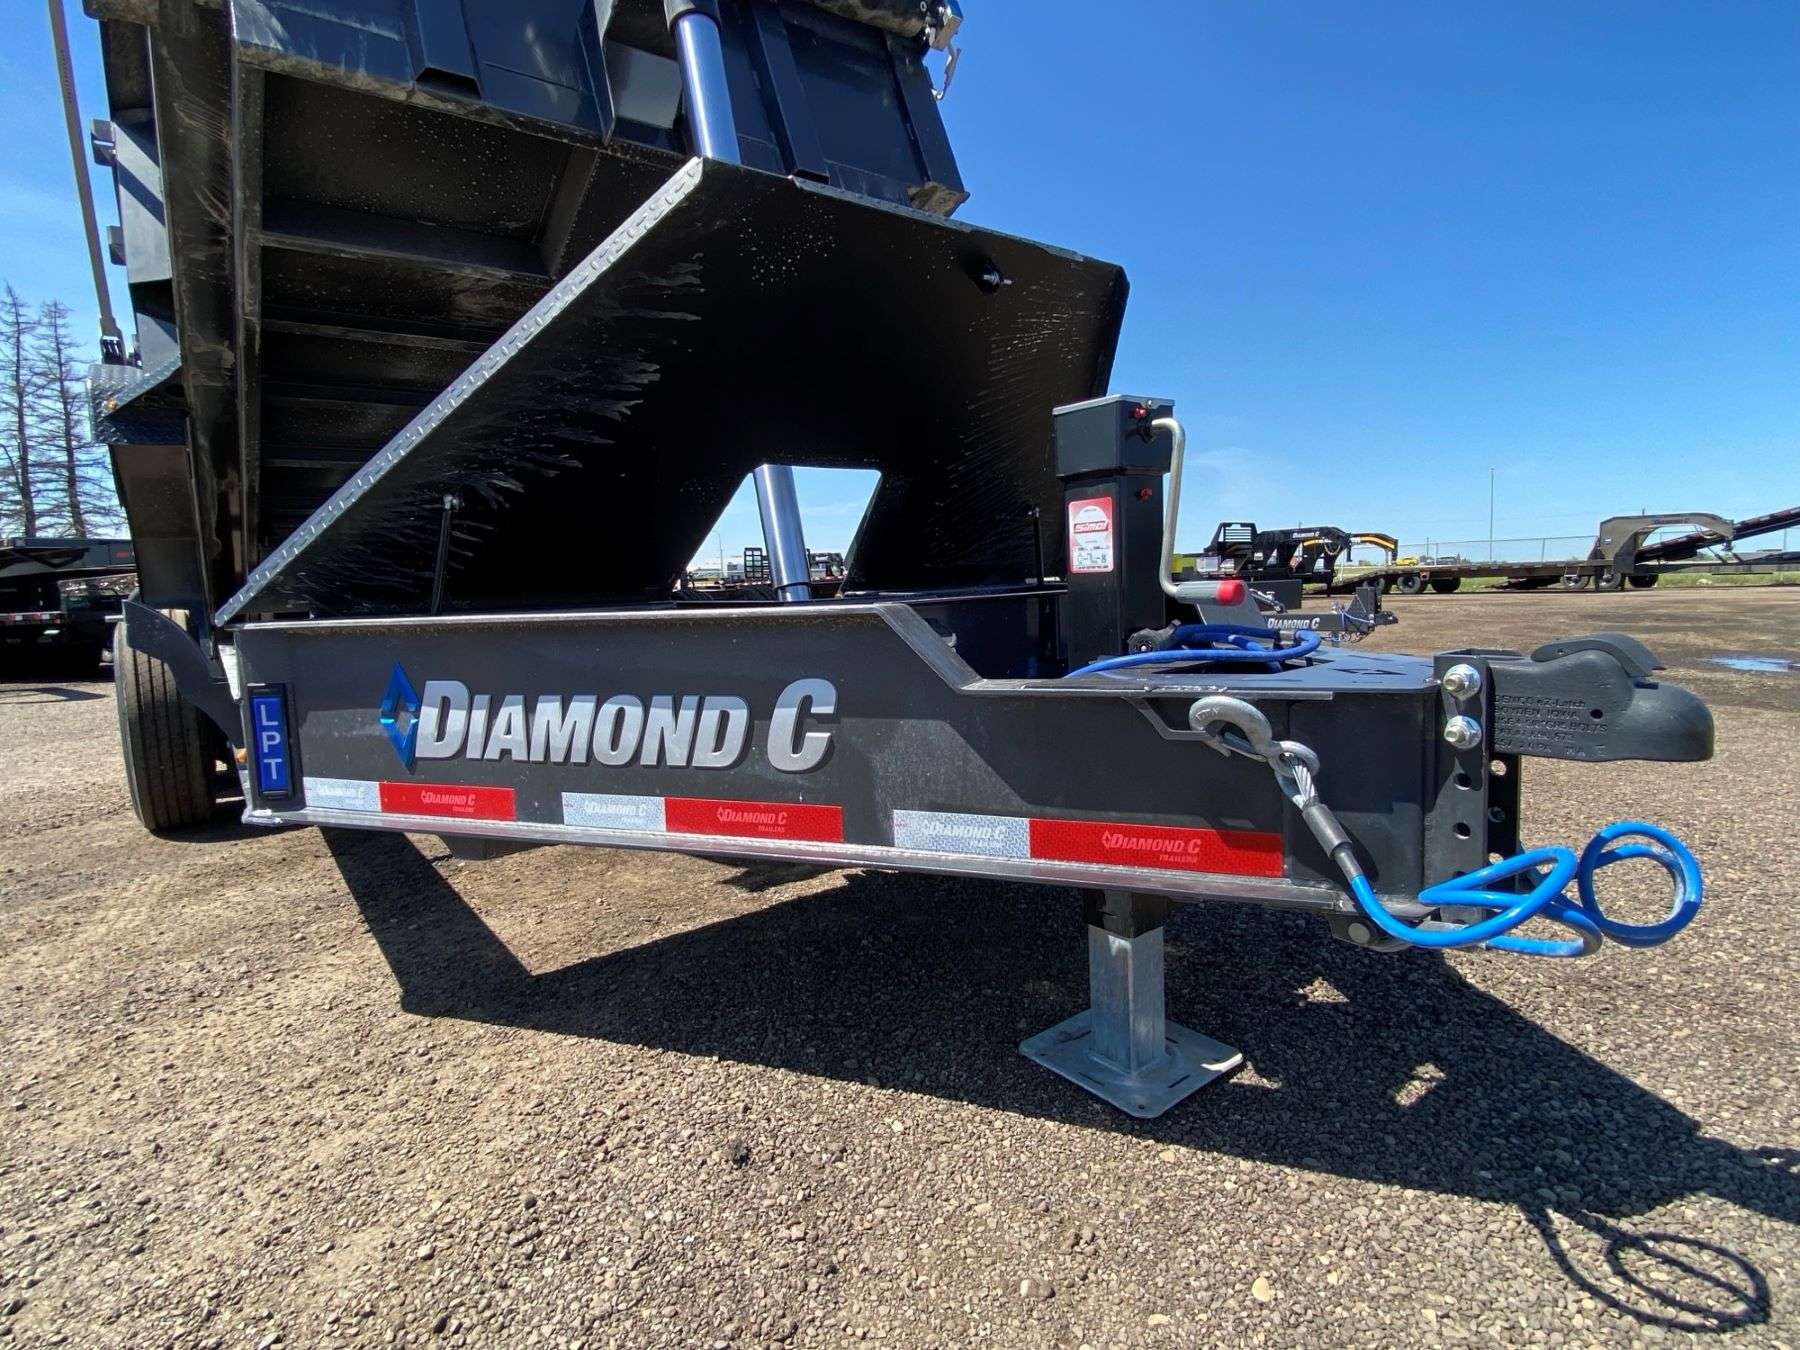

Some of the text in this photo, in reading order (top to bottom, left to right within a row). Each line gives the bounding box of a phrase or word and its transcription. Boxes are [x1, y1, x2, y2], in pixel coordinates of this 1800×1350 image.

[1267, 617, 1321, 630] DIAMOND C
[415, 678, 838, 772] DIAMOND C
[260, 704, 285, 780] LPT
[425, 791, 476, 807] DIAMOND C
[723, 808, 788, 825] DIAMOND C
[1110, 833, 1202, 854] DIAMOND C
